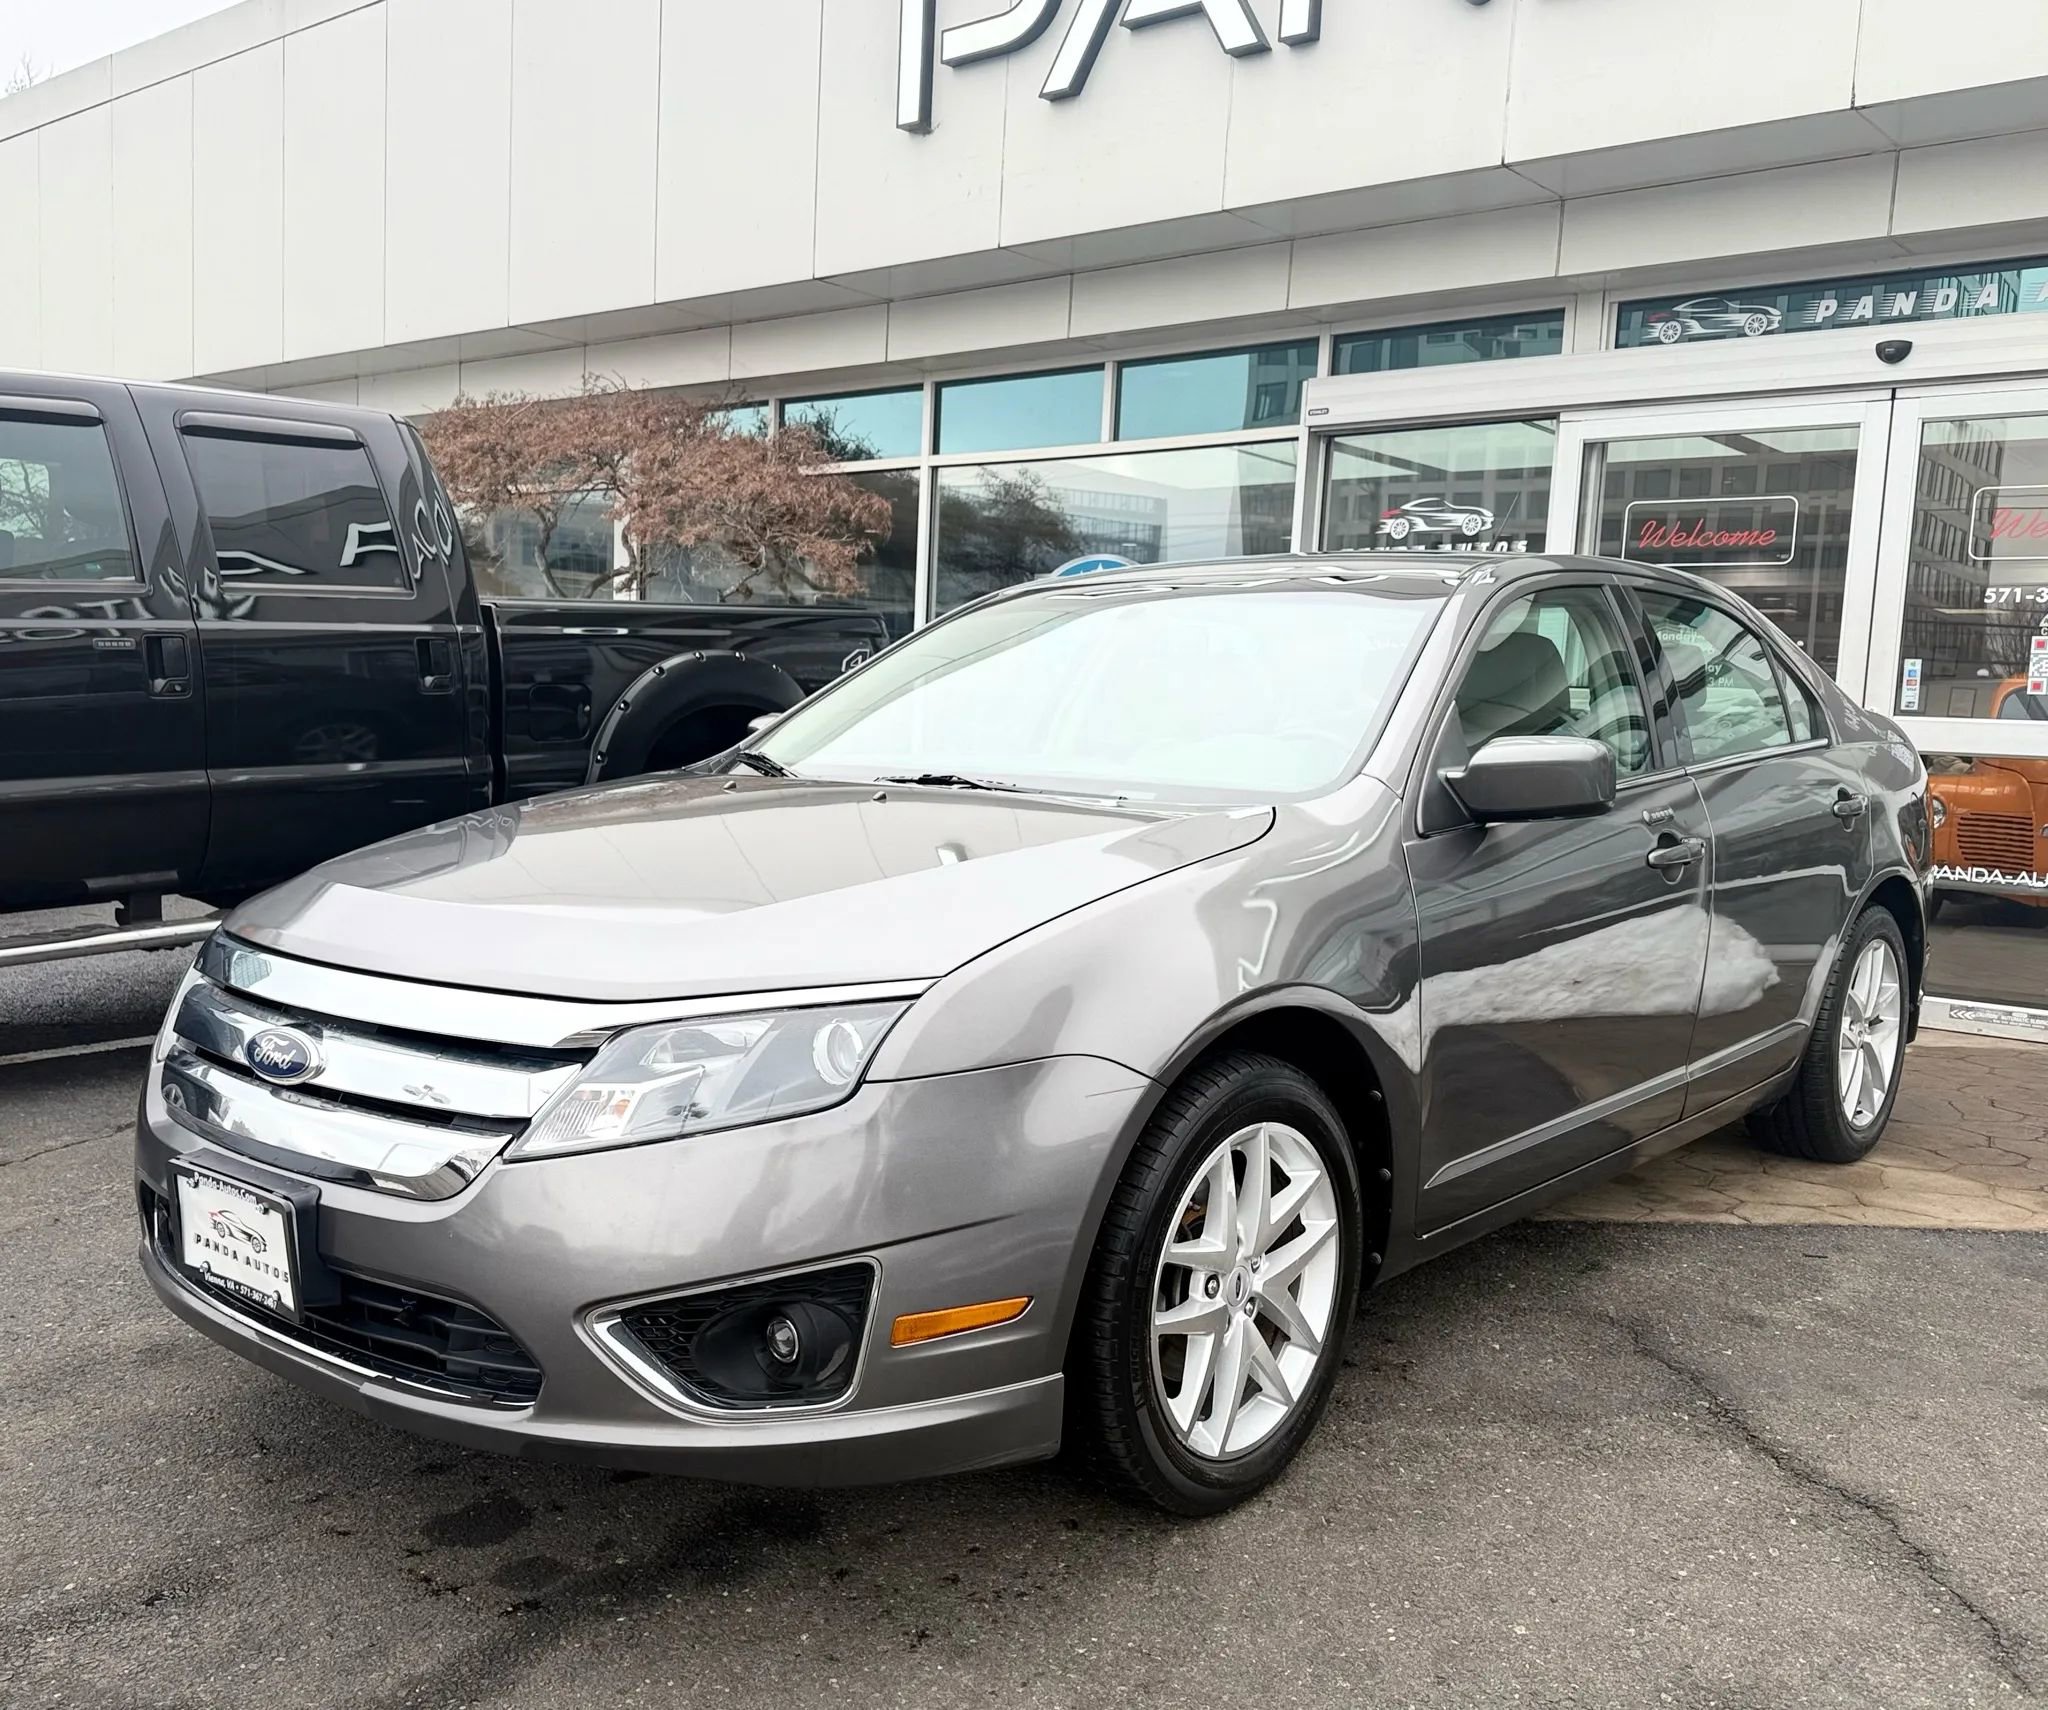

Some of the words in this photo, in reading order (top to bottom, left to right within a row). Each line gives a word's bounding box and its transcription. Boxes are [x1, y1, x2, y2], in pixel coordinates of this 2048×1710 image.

[1808, 283, 1999, 324] PANDA
[1638, 517, 1777, 549] Welcome
[254, 1035, 296, 1069] Ford
[194, 1232, 239, 1261] PANDA
[244, 1255, 289, 1284] AUTOS
